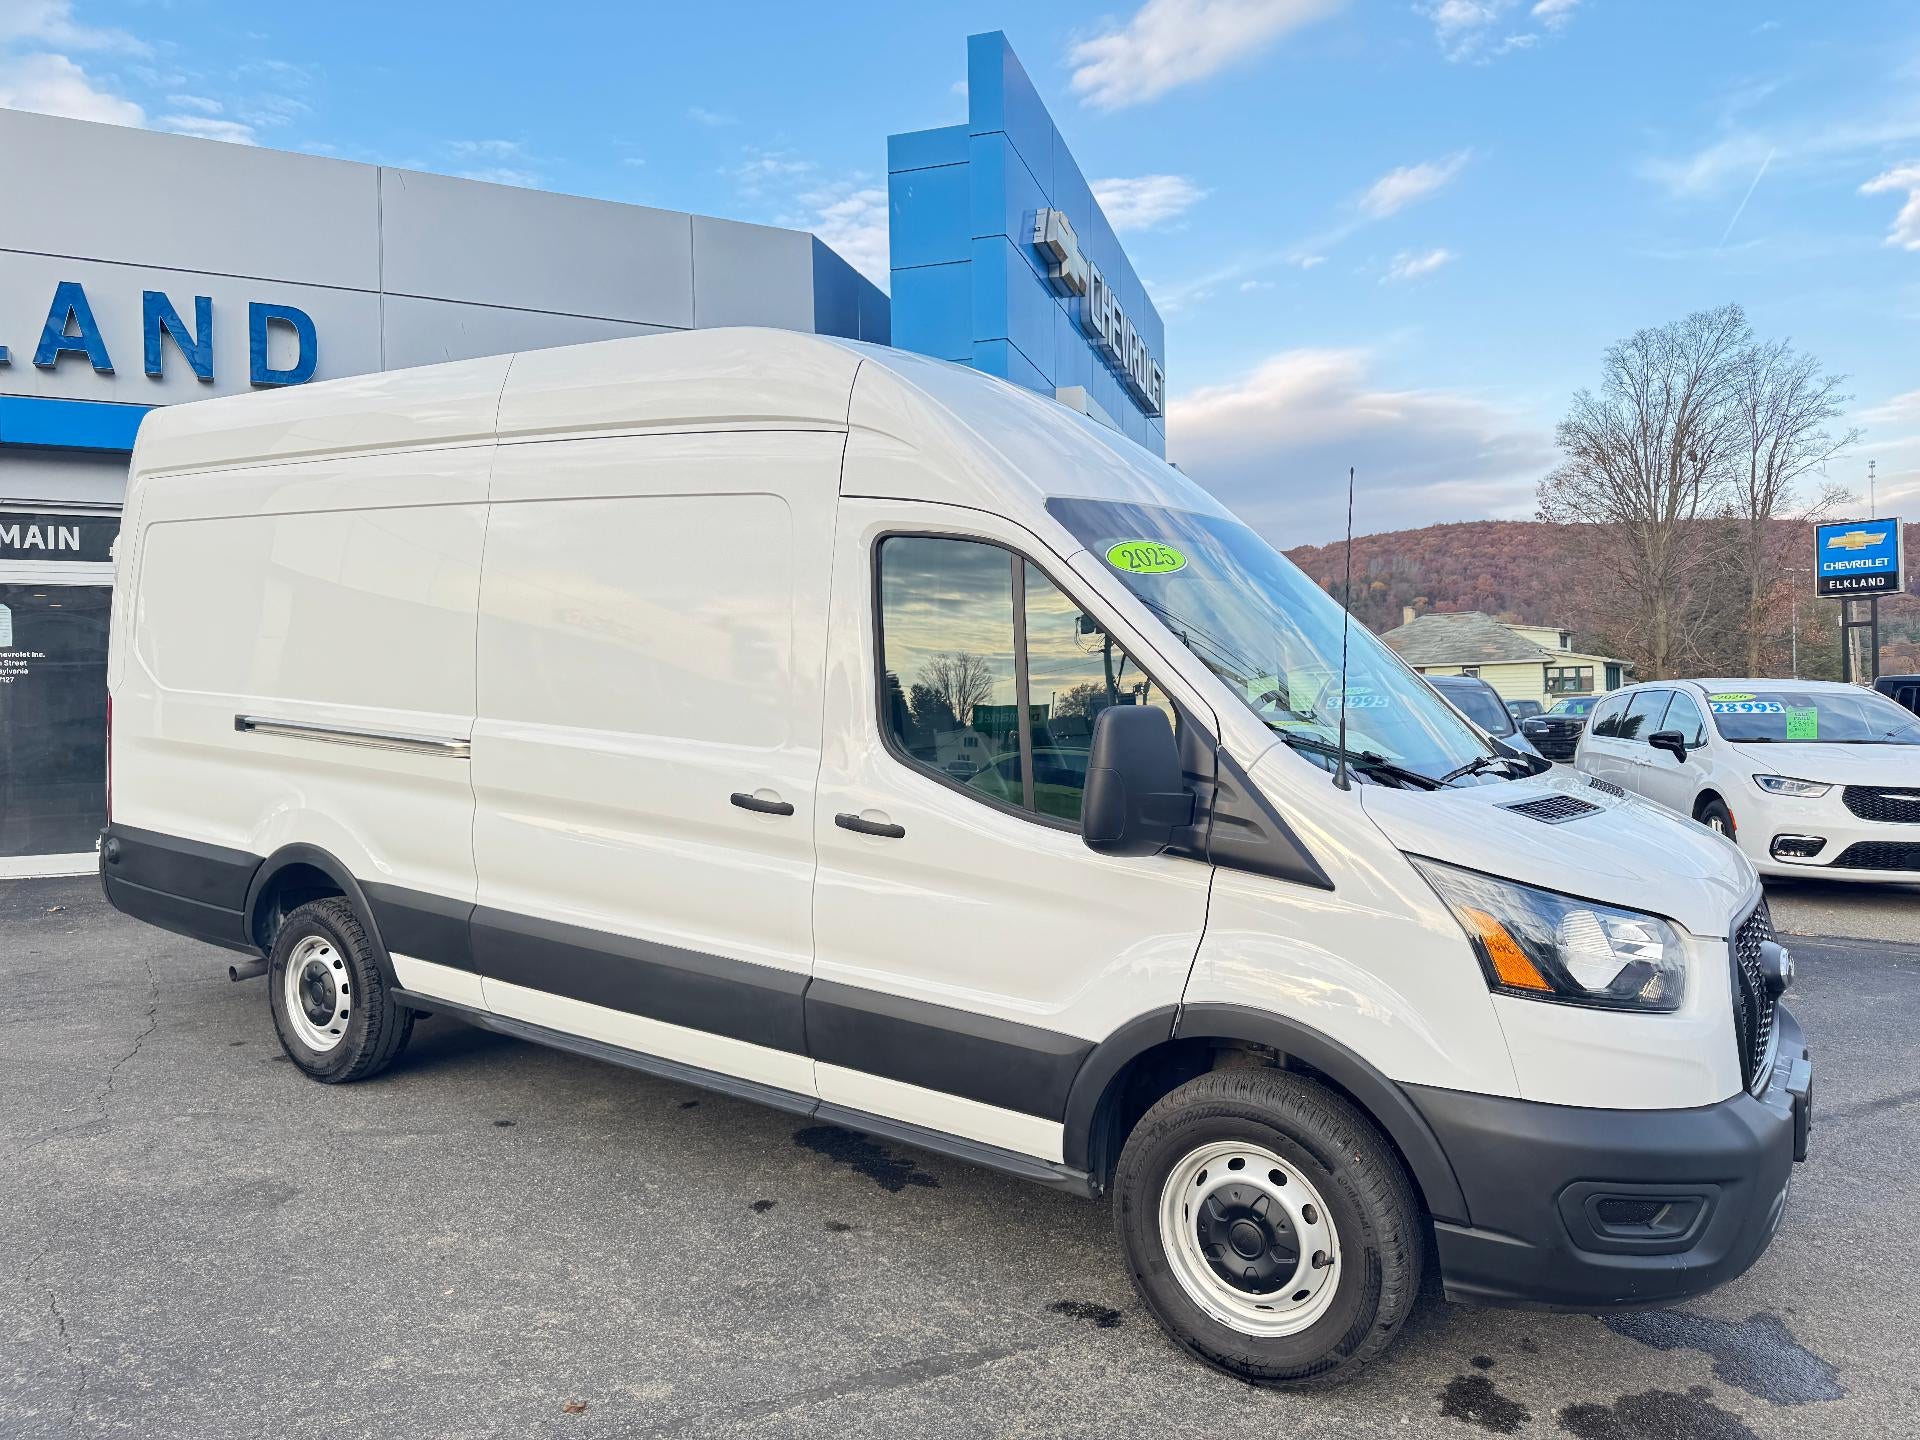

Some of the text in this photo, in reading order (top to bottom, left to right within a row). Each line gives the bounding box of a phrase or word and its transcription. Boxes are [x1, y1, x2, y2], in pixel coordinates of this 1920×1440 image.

[0, 281, 318, 386] AND
[1082, 260, 1165, 417] CHEVROLET
[0, 524, 80, 551] MAIN
[1121, 547, 1176, 569] 2025
[1824, 558, 1889, 570] CHEVROLET
[1829, 577, 1885, 589] ELKLAND
[1712, 702, 1781, 713] 28995
